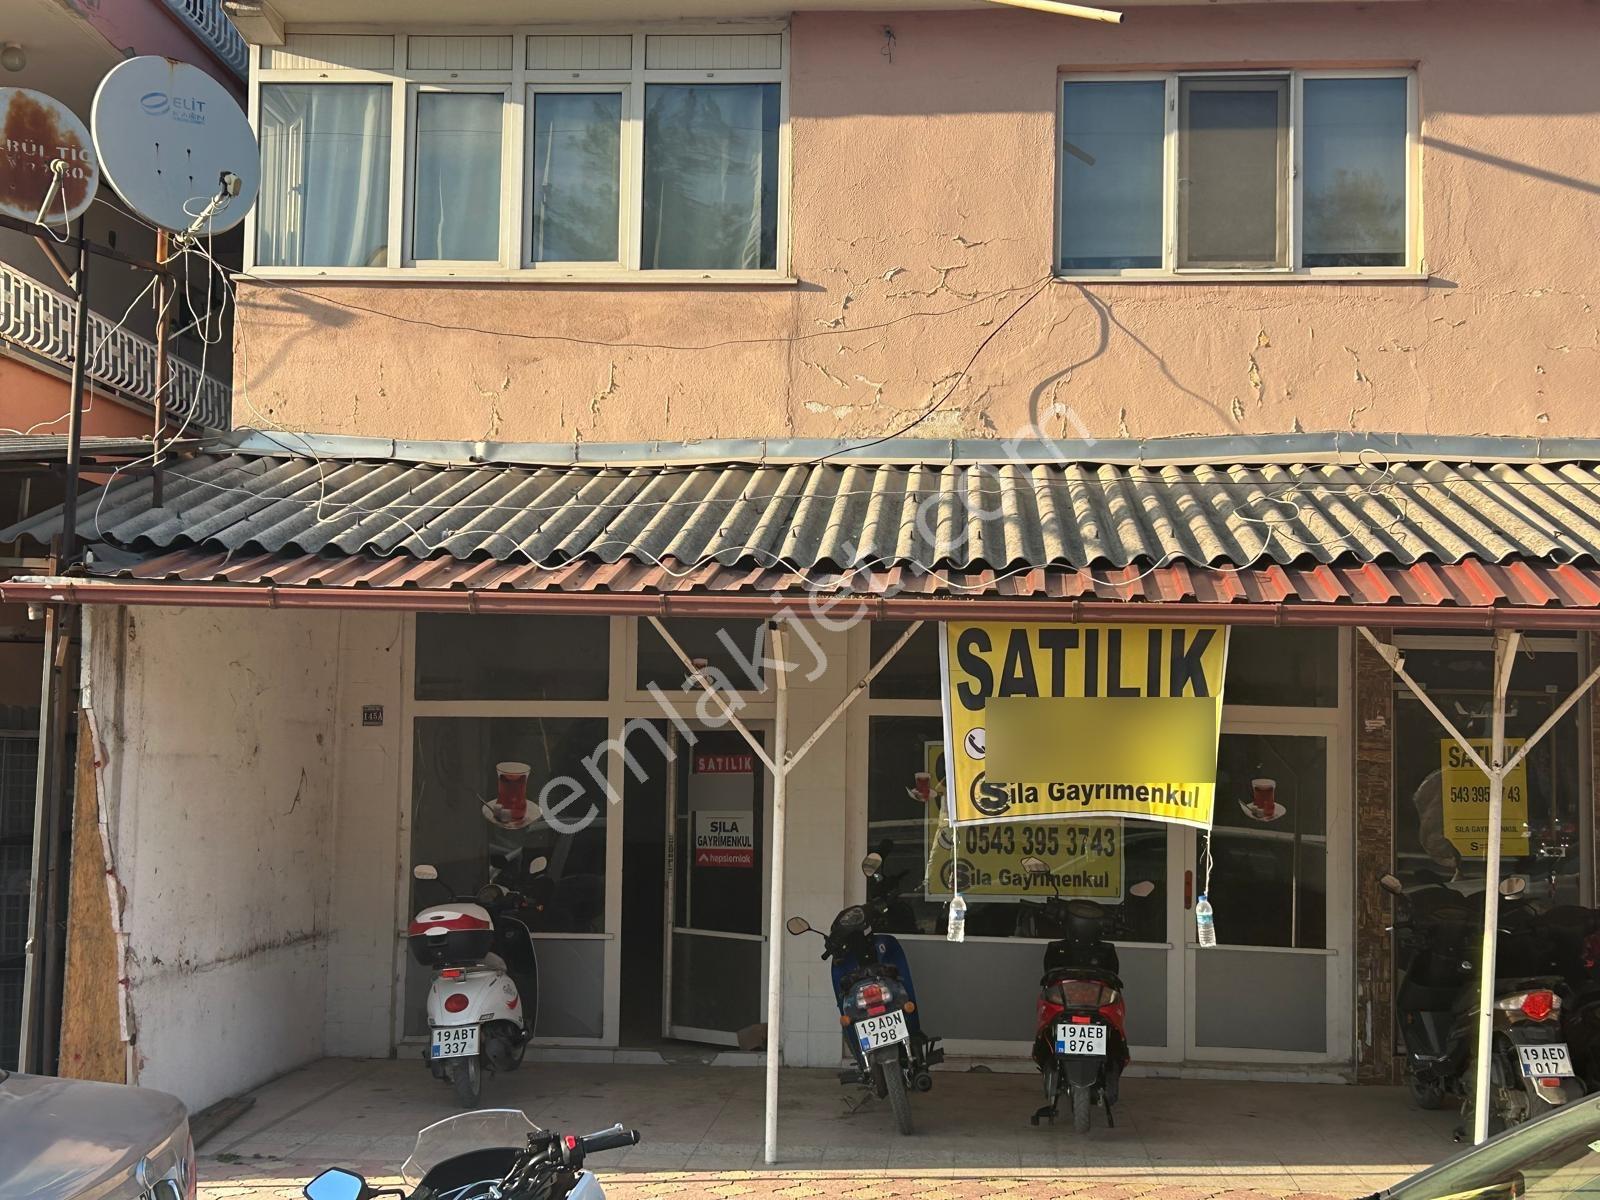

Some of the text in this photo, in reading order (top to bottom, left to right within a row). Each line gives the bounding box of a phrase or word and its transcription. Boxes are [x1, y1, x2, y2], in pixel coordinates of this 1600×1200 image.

[957, 627, 1217, 711] SATILIK
[698, 757, 752, 770] SATILIK
[1450, 786, 1469, 803] 543
[1471, 786, 1490, 803] 395
[1508, 786, 1521, 803] 43
[966, 826, 1116, 857] 0543 395 3743
[873, 1029, 897, 1045] 798
[444, 1042, 467, 1054] 337
[1069, 1040, 1094, 1052] 876
[1535, 1062, 1559, 1074] 017
